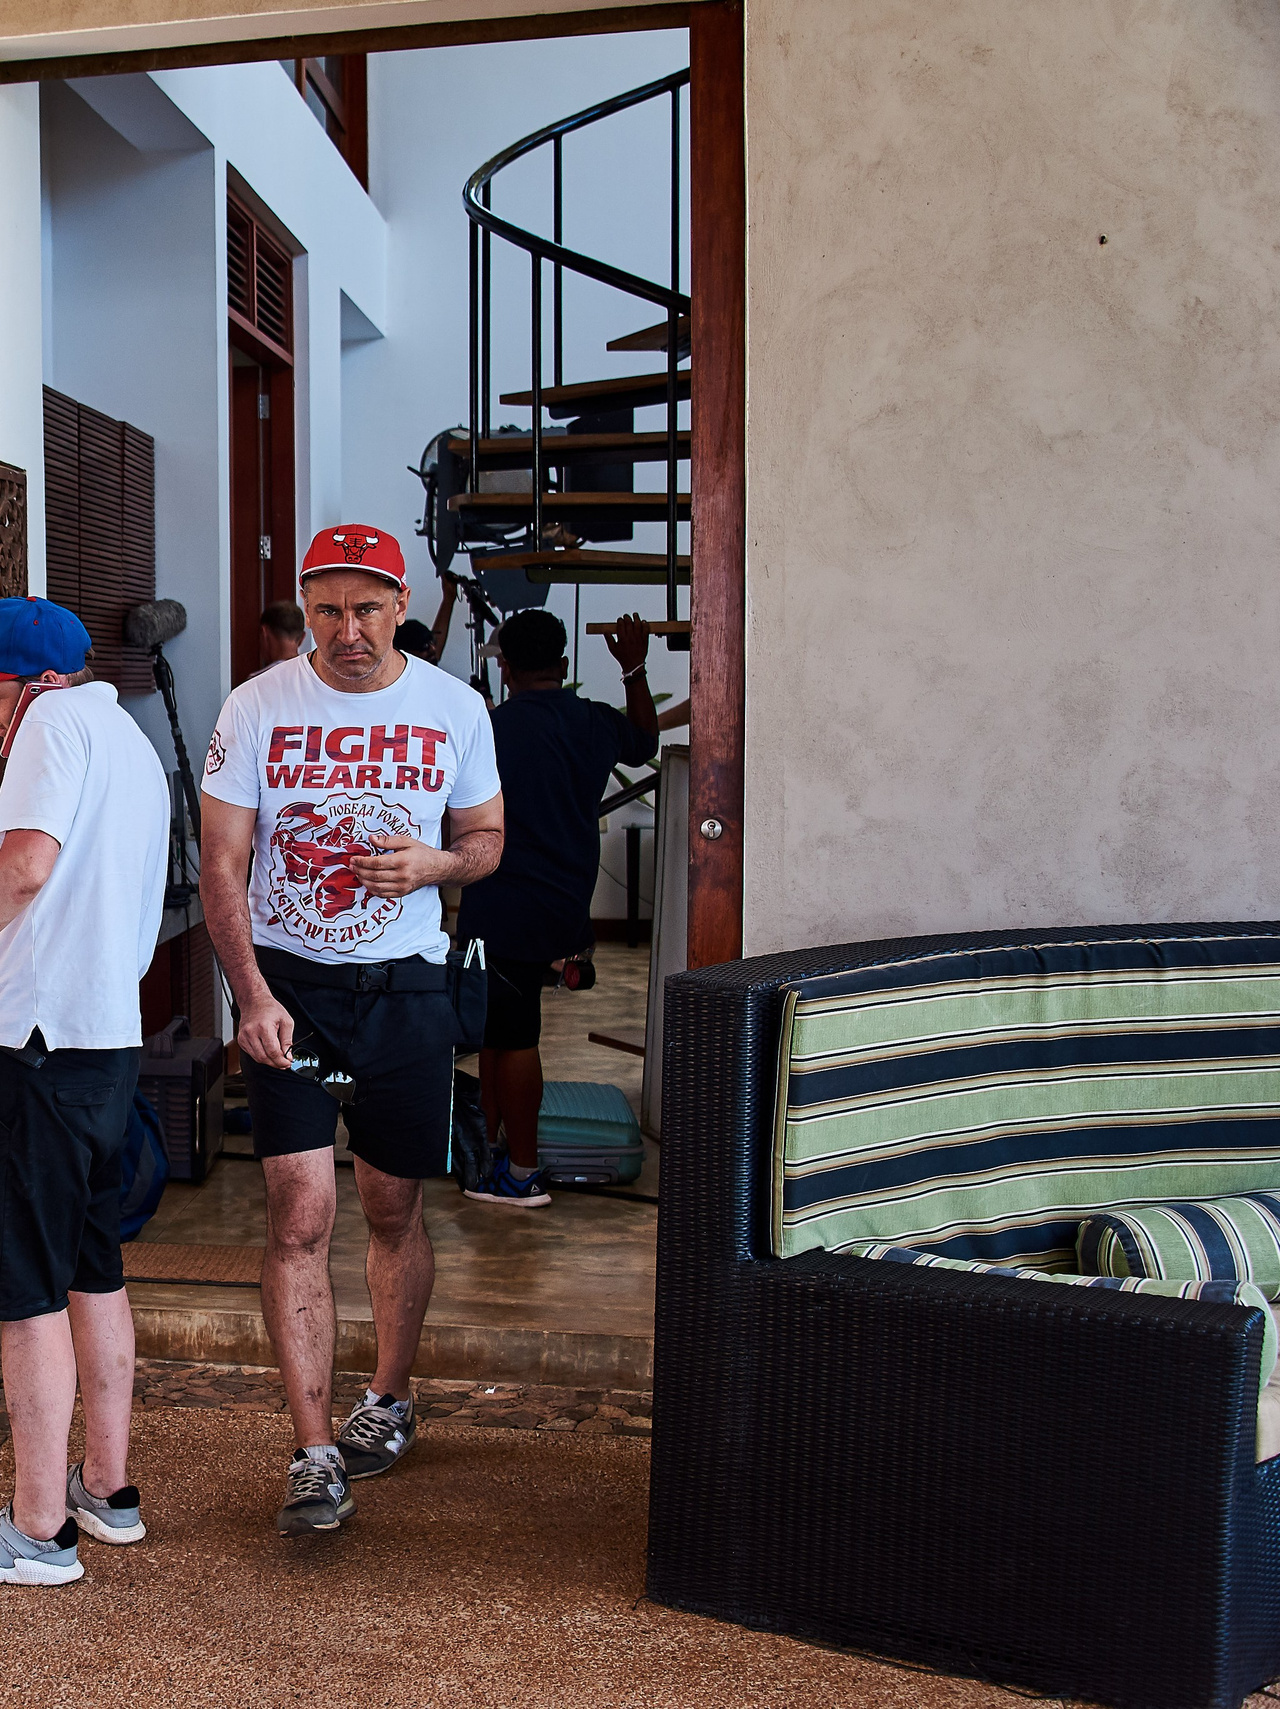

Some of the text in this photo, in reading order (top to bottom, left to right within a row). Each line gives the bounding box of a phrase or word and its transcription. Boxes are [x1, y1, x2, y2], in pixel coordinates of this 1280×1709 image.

[267, 724, 447, 766] FIGHT
[265, 764, 445, 792] WEAR.RU
[329, 803, 375, 817] ПОБЕДА
